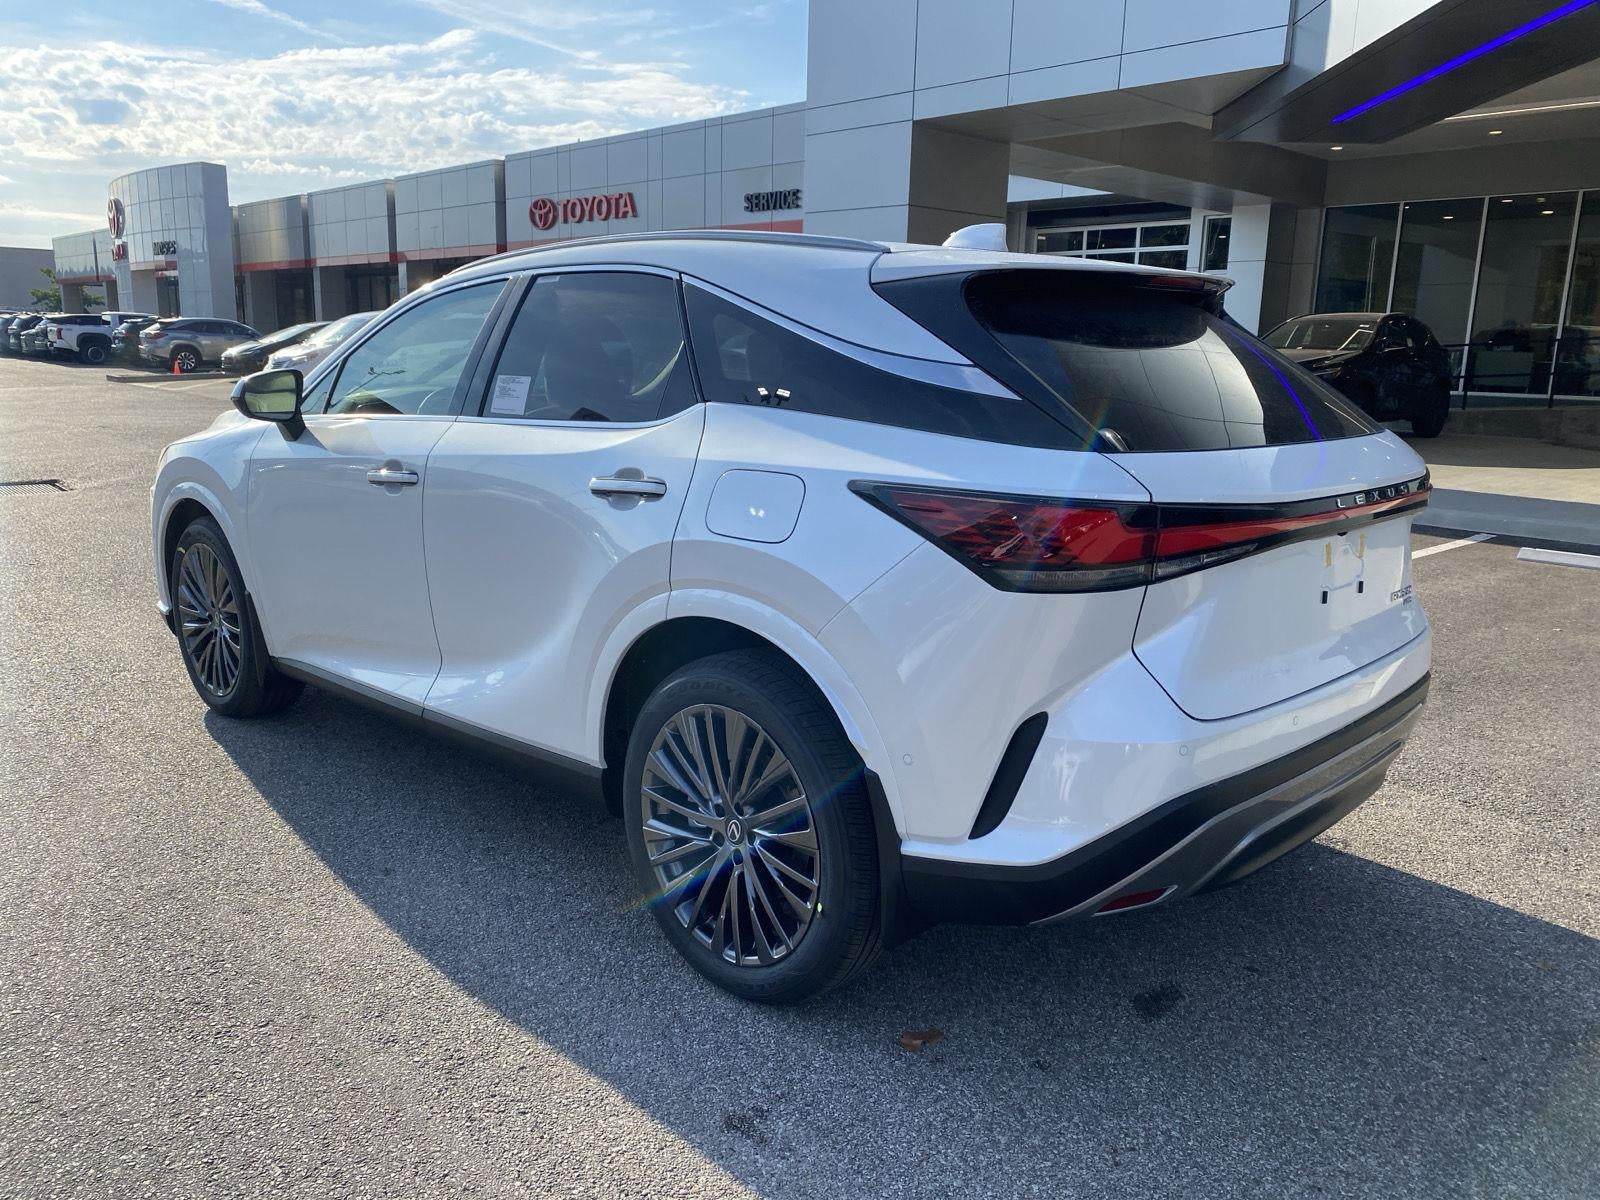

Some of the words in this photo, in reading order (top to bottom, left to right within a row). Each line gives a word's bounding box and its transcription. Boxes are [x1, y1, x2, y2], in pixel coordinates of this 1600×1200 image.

[559, 191, 637, 224] TOYOTA
[743, 188, 802, 212] SERVICE
[1337, 485, 1408, 508] LEXUS
